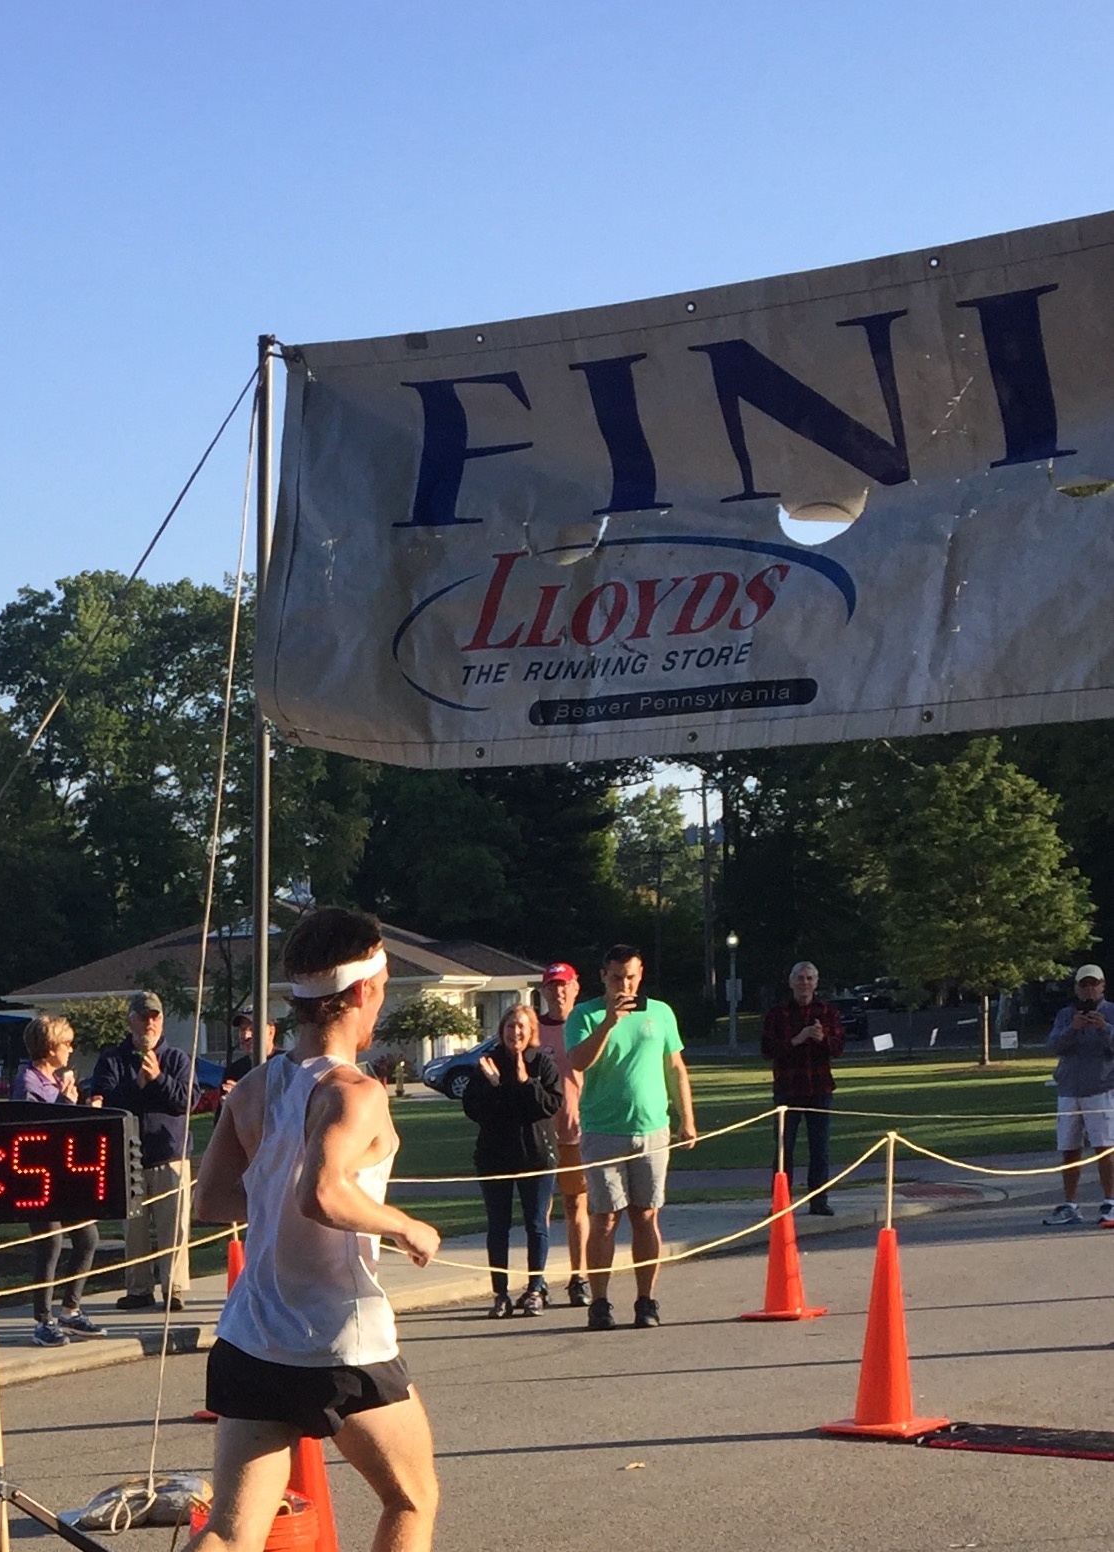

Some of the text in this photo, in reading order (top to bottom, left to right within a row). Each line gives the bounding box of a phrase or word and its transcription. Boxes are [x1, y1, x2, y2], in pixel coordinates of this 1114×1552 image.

[391, 283, 1078, 527] FINI
[461, 551, 791, 651] LLOYDS
[461, 641, 754, 686] THE RUNNING STORE
[555, 685, 792, 721] Beaver Pennsylvania
